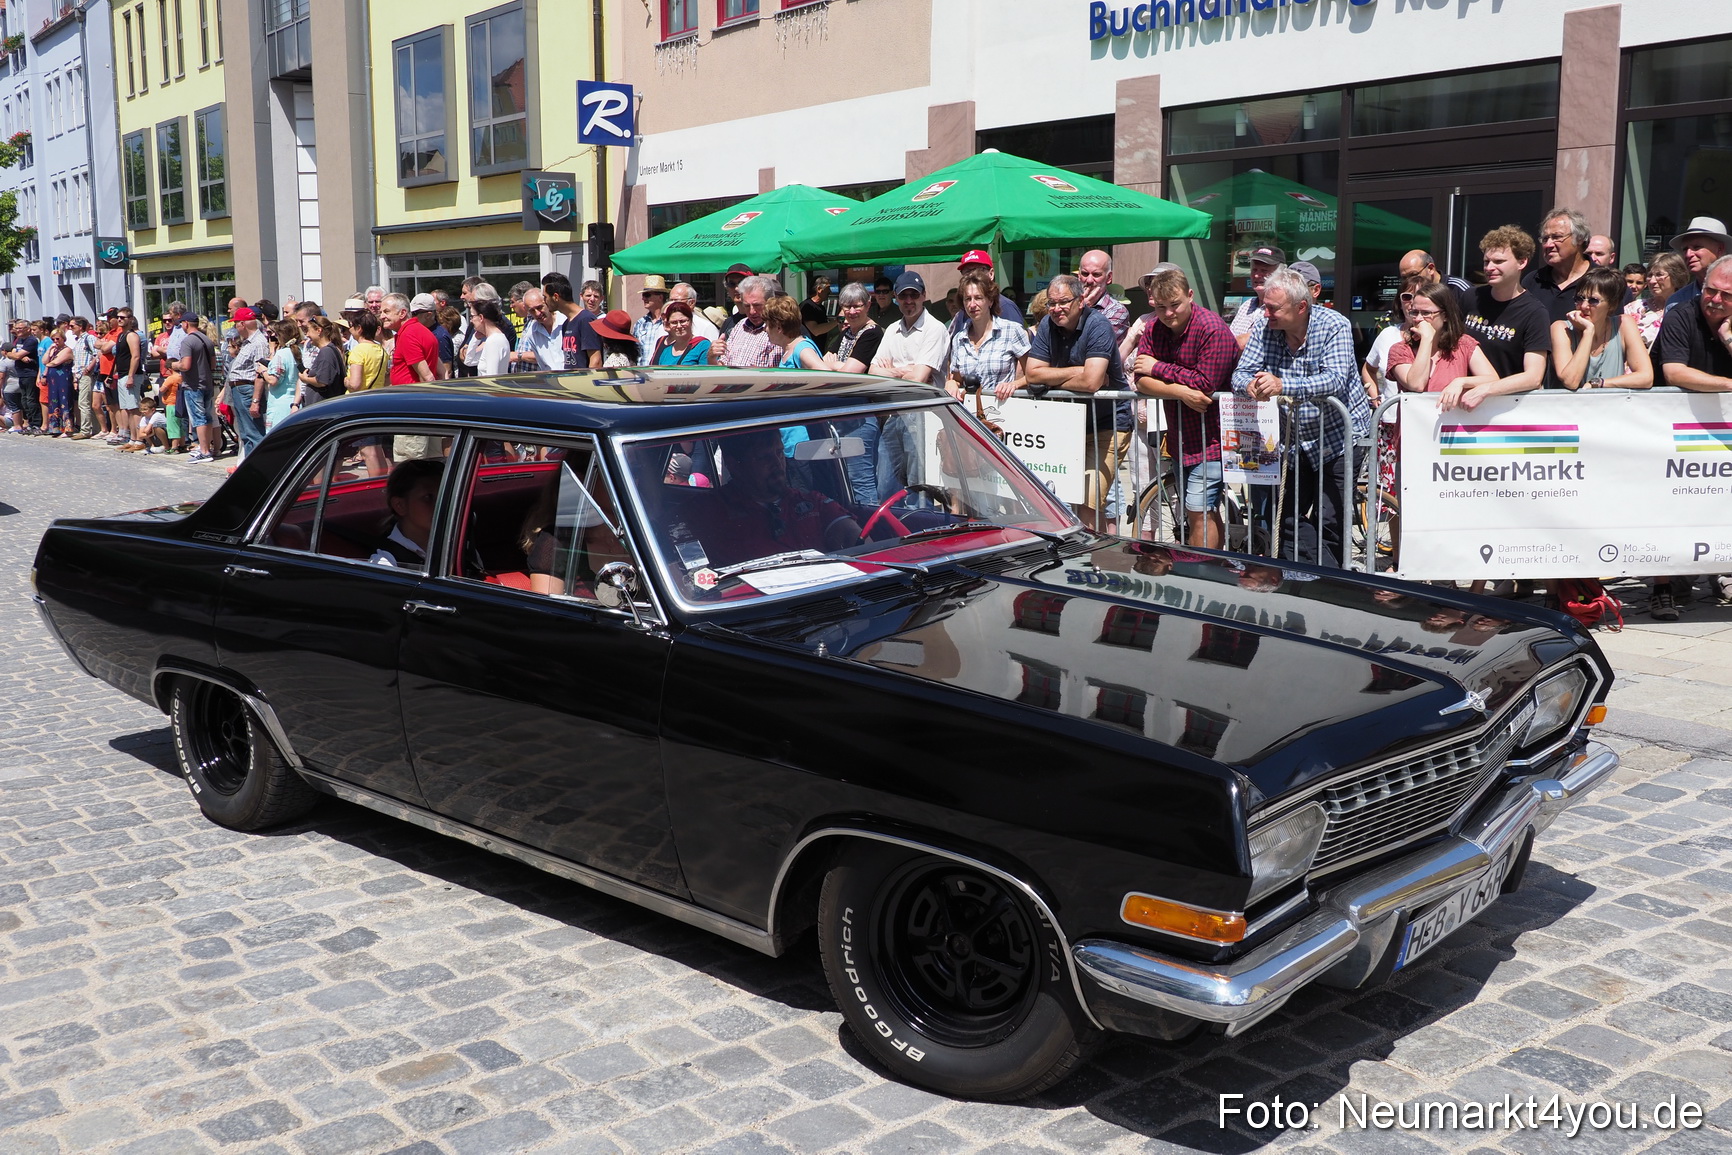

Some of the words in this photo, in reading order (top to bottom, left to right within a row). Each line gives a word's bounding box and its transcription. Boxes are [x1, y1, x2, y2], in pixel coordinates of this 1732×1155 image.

[639, 163, 659, 176] Unterer
[659, 161, 676, 173] Markt
[676, 159, 684, 171] 15
[877, 202, 945, 215] Neumarkter
[850, 207, 945, 226] Lammsbräu
[1237, 220, 1273, 231] OLDTIMER
[668, 238, 744, 249] Lammsbräu
[1432, 460, 1585, 482] NeuerMarkt
[1439, 489, 1489, 499] einkaufen
[1495, 488, 1525, 498] leben
[1530, 487, 1579, 500] genießen
[1671, 485, 1724, 495] einkaufen
[1498, 543, 1557, 553] Dammstraße
[1559, 543, 1564, 552] 1
[1498, 555, 1543, 564] Neumarkt
[1653, 554, 1671, 563] Uhr
[697, 573, 716, 585] 82
[1406, 905, 1448, 961] HEB
[1457, 887, 1473, 924] Y
[841, 906, 926, 1062] BFGoodrich
